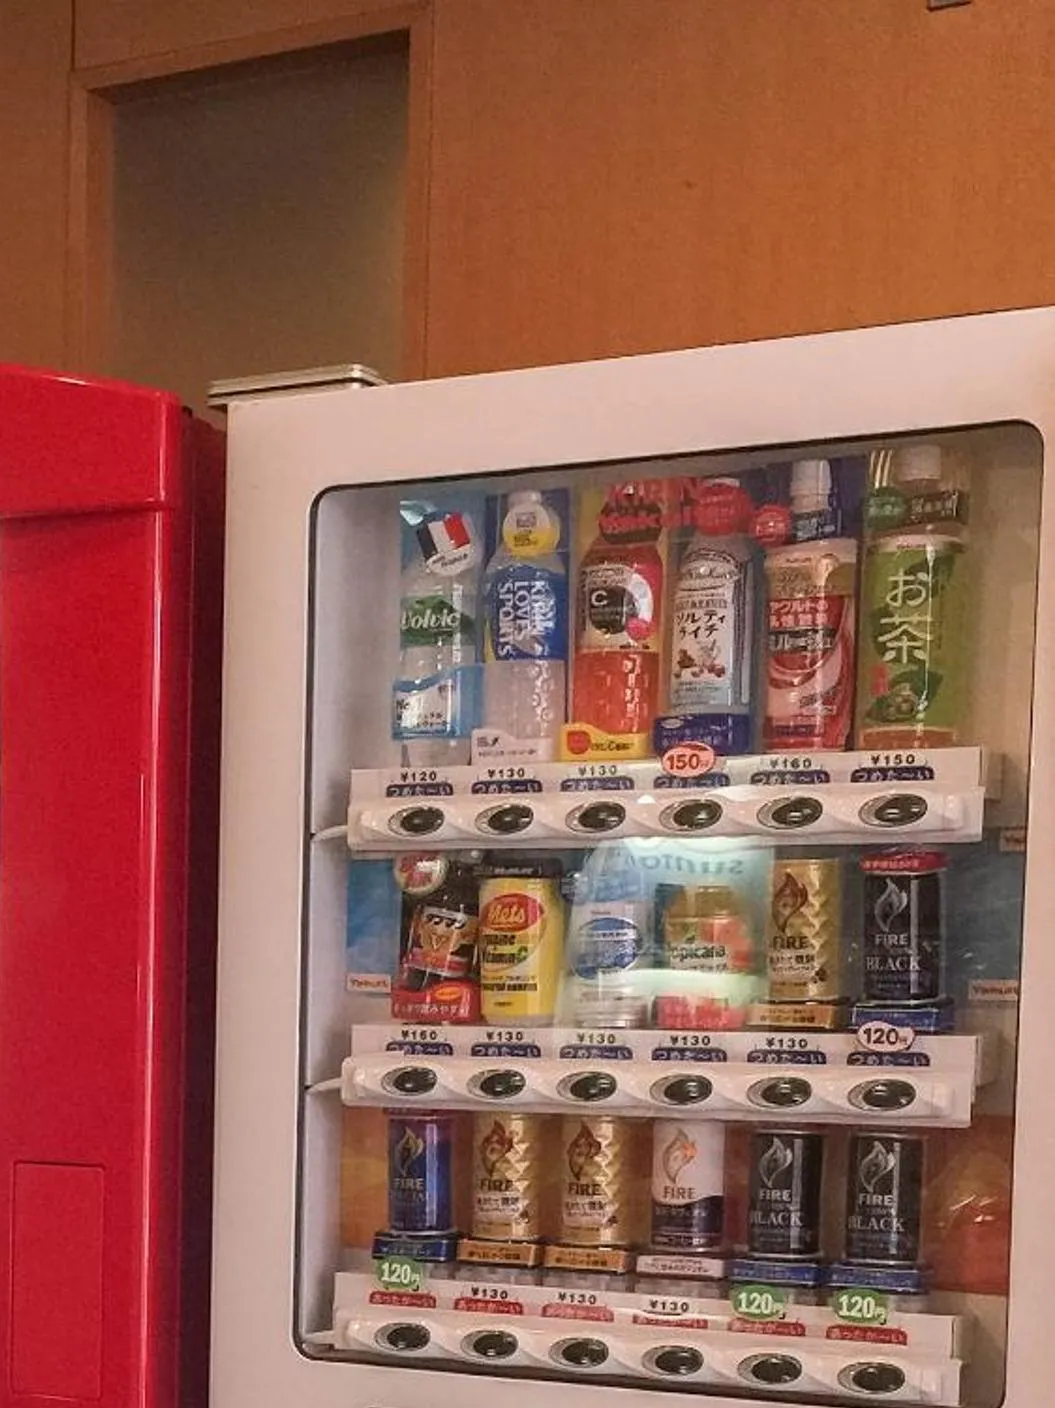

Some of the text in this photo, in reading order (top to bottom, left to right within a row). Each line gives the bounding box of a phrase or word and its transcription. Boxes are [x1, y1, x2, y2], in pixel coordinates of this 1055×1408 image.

[677, 610, 725, 625] ソルティ
[877, 570, 934, 665] お茶
[871, 754, 915, 766] ¥150
[400, 771, 437, 782] ¥120
[487, 767, 526, 779] ¥130
[578, 765, 617, 776] ¥130
[875, 935, 910, 947] FIRE
[865, 955, 921, 971] BLACK
[486, 1031, 524, 1042] ¥130
[576, 1033, 616, 1044] ¥130
[669, 1035, 711, 1046] ¥130
[766, 1038, 809, 1049] ¥130
[568, 1183, 602, 1197] FIRE
[663, 1185, 696, 1199] FIRE
[760, 1188, 794, 1202] FIRE
[860, 1192, 894, 1206] FIRE
[471, 1287, 508, 1299] ¥130
[557, 1291, 597, 1305] ¥130
[649, 1299, 690, 1313] ¥130
